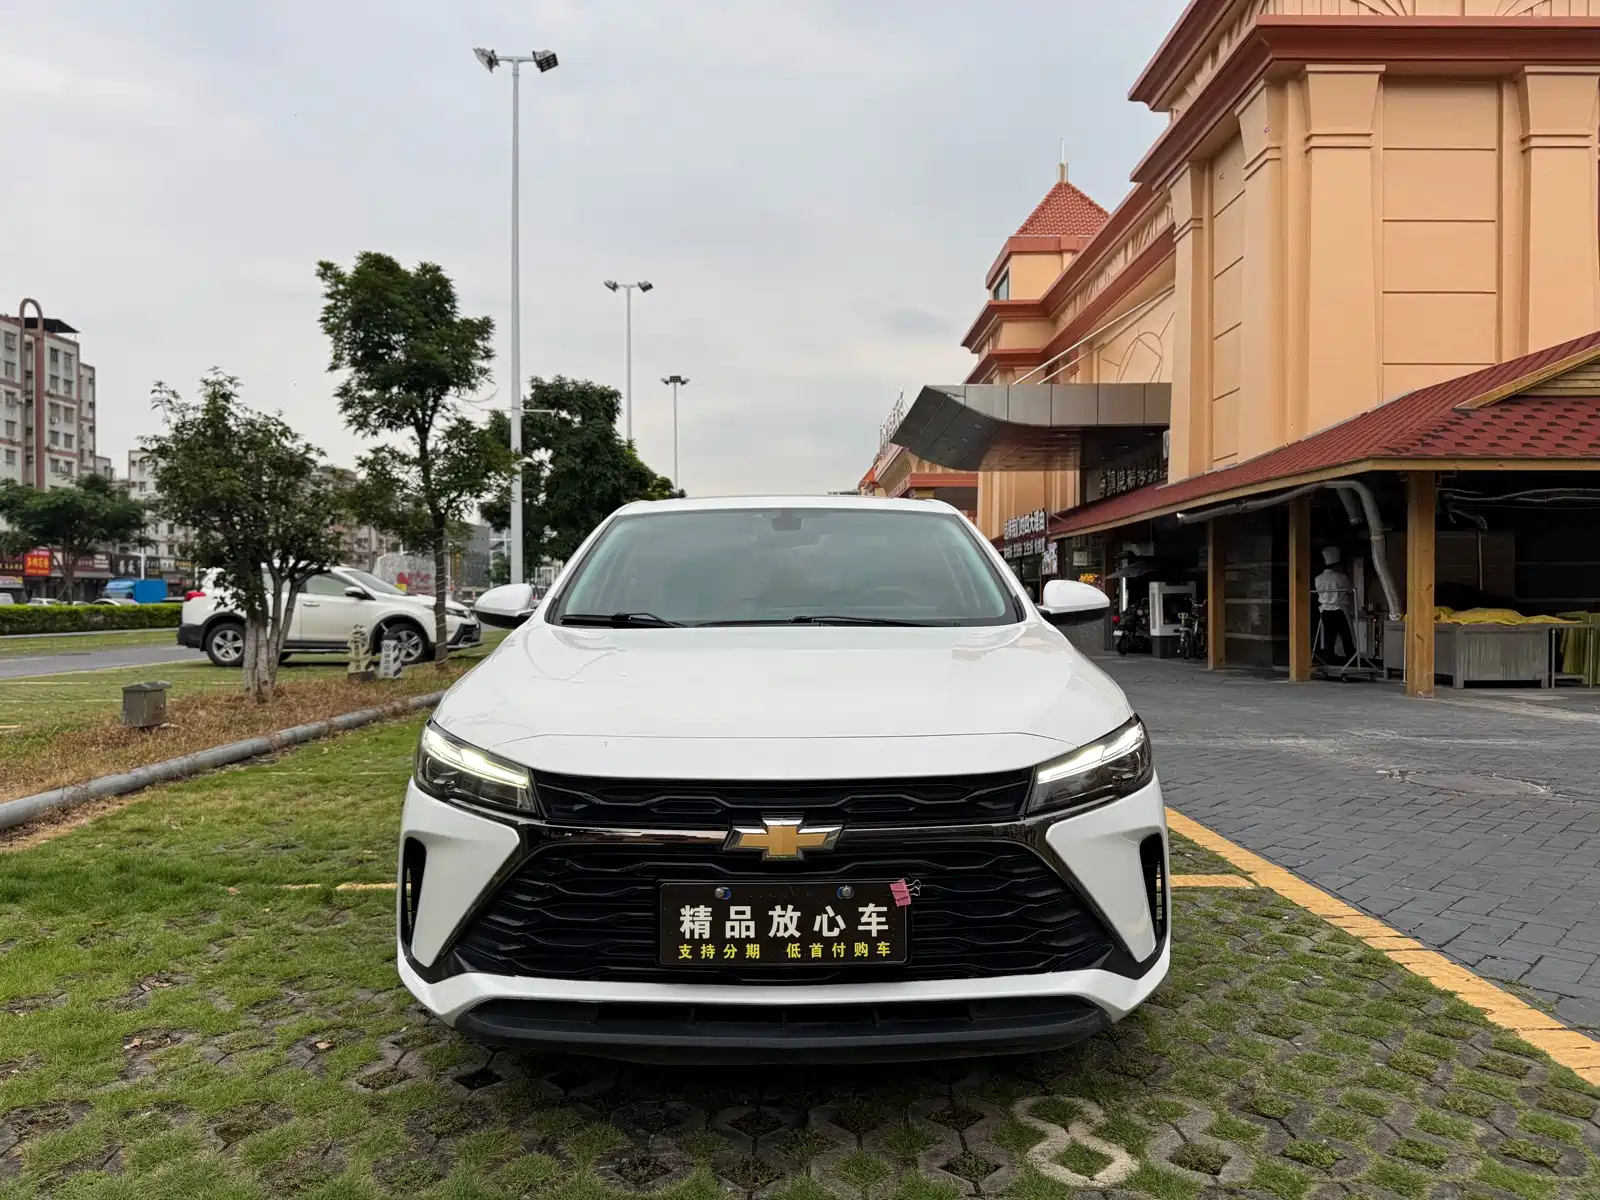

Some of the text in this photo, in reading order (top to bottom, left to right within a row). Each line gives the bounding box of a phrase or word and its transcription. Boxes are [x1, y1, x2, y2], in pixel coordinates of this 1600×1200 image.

[680, 903, 888, 939] 精品放心车
[678, 941, 891, 960] 支持分期 低首付购车
